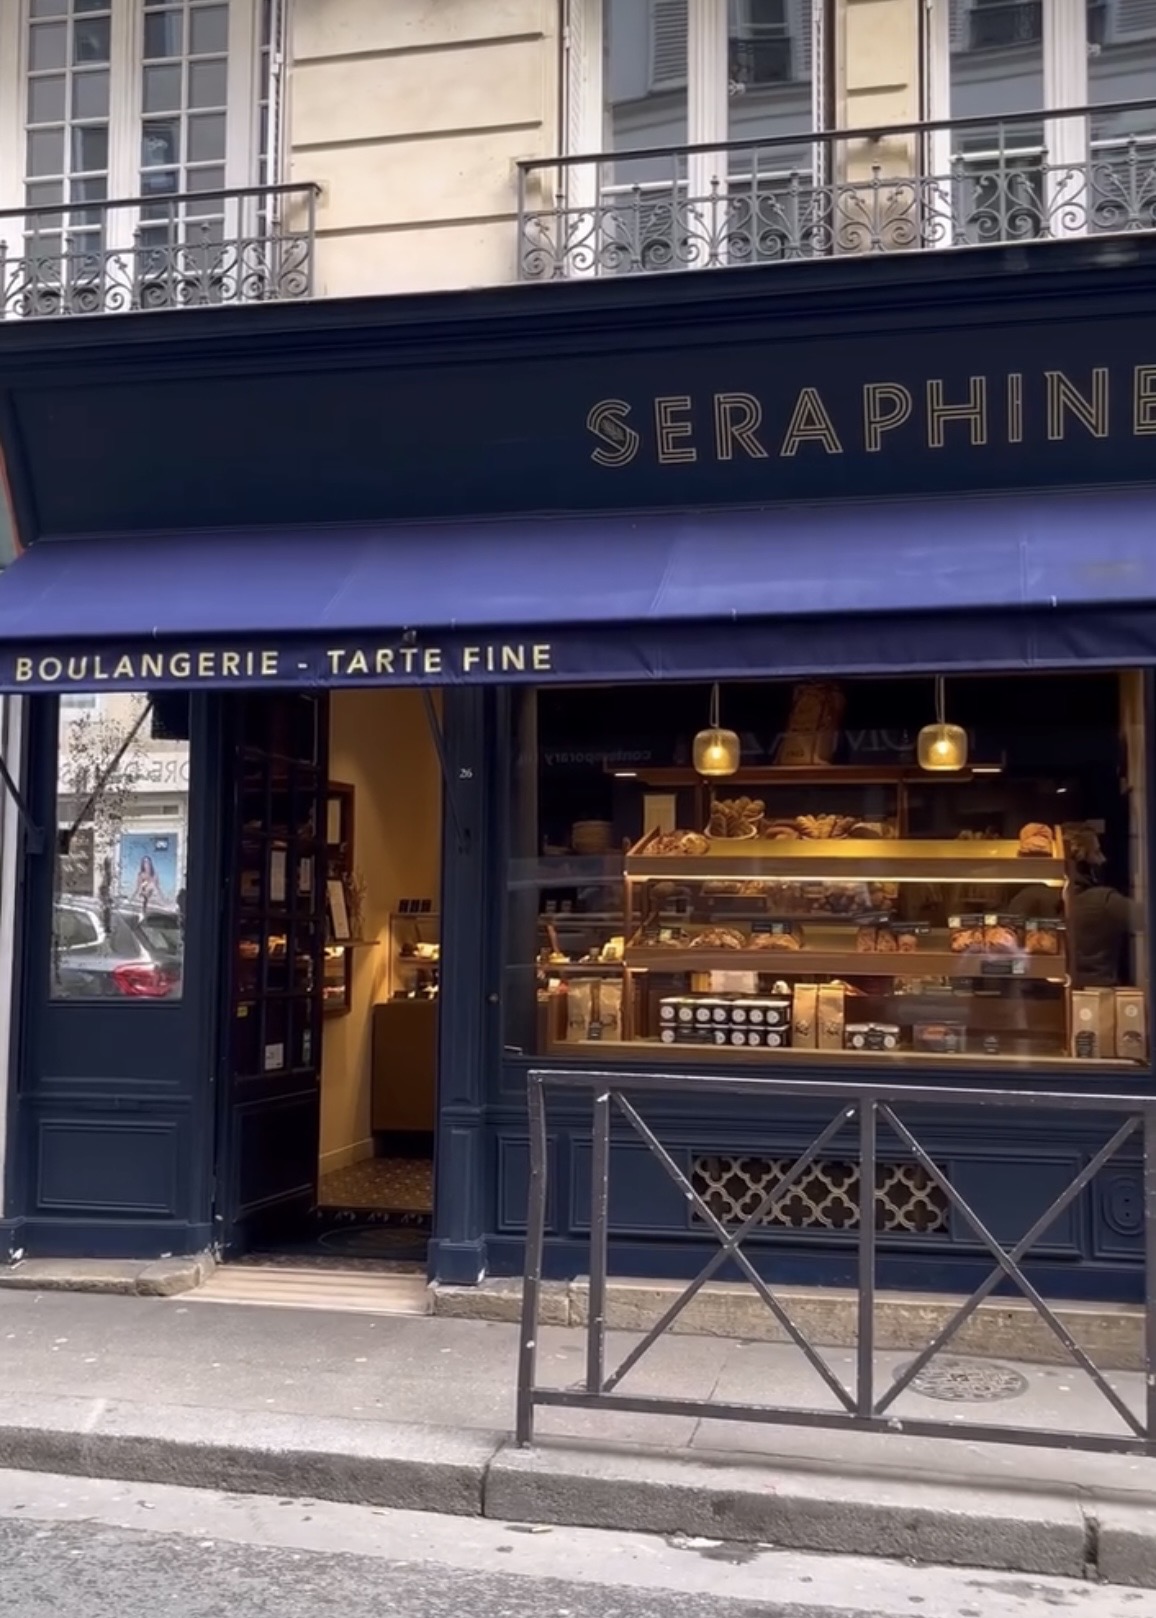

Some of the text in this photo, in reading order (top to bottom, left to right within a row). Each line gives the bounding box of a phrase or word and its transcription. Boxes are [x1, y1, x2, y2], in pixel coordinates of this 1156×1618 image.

[586, 363, 1156, 468] SERAPHINE
[15, 650, 280, 682] BOULANGERIE
[327, 648, 443, 674] TARTE
[463, 644, 552, 671] FINE
[459, 768, 473, 778] 26
